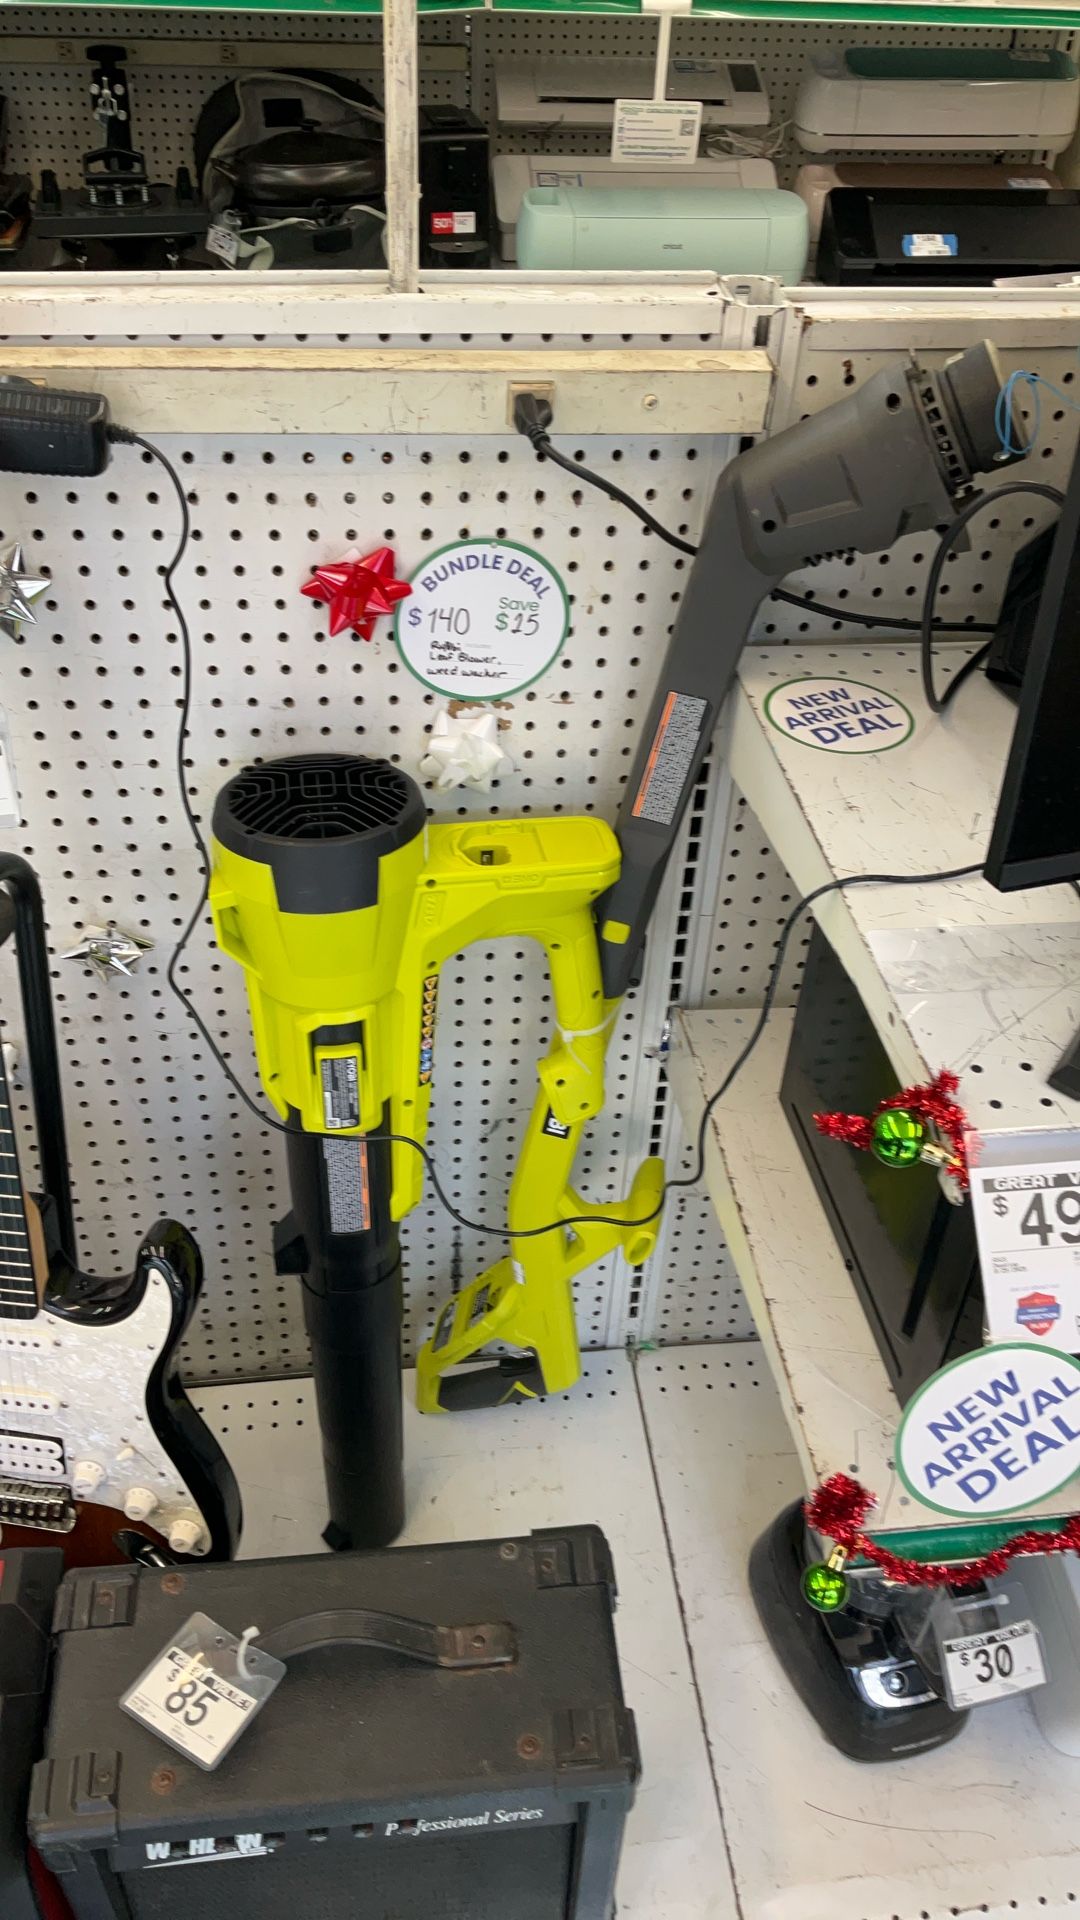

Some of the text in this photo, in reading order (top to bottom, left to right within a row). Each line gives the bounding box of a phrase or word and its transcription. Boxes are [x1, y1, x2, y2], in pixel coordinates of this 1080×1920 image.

[421, 553, 550, 600] BUNDLE DEAL
[784, 696, 894, 730] ARRIVAL
[787, 687, 851, 710] NEW
[809, 713, 904, 745] DEAL
[993, 1173, 1058, 1191] GREAT
[926, 1369, 1022, 1444] NEW
[923, 1376, 1080, 1489] ARRIVAL
[956, 1415, 1080, 1504] DEAL
[384, 1807, 544, 1837] Pfessional Series
